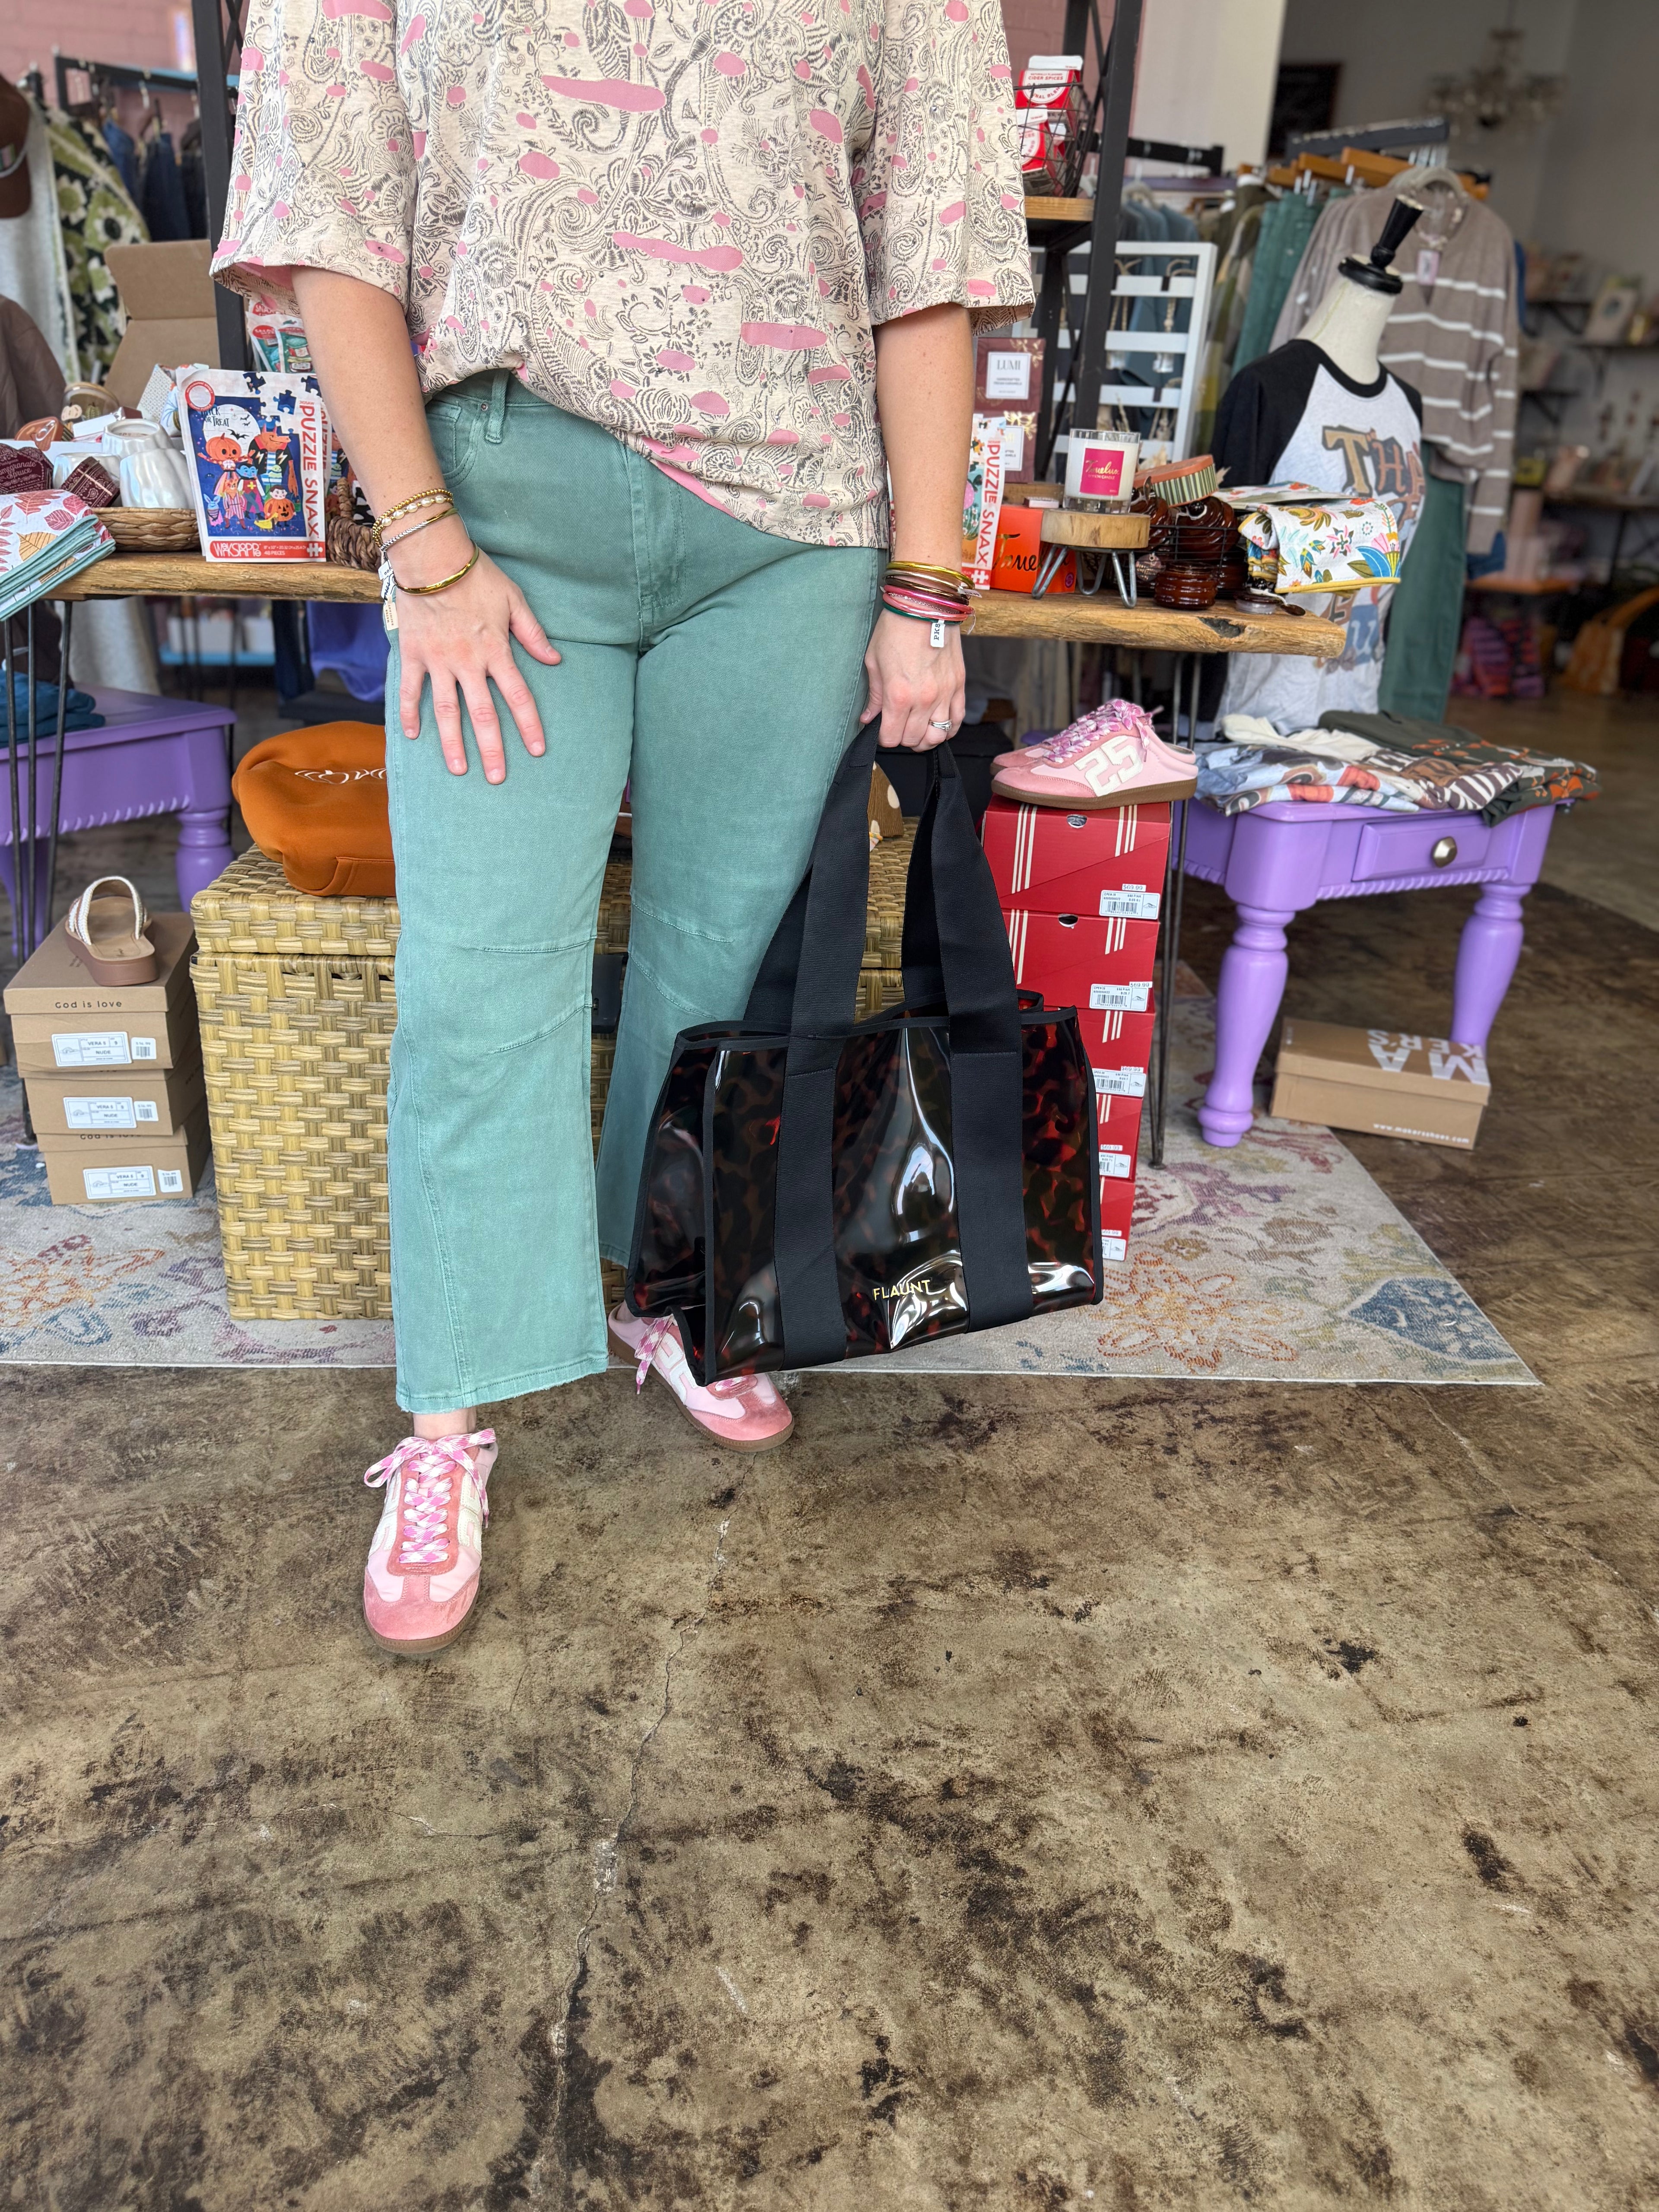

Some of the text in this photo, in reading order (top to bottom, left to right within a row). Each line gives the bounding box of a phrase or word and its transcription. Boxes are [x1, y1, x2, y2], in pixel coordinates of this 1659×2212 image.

[997, 360, 1021, 370] LUMI
[211, 416, 229, 427] TREAT
[6, 468, 32, 479] Spruce
[299, 405, 318, 537] PUZZLE SNAX
[977, 445, 1001, 567] PUZZLE SNAX
[1074, 735, 1143, 797] 25
[873, 1279, 930, 1300] FLAUNT
